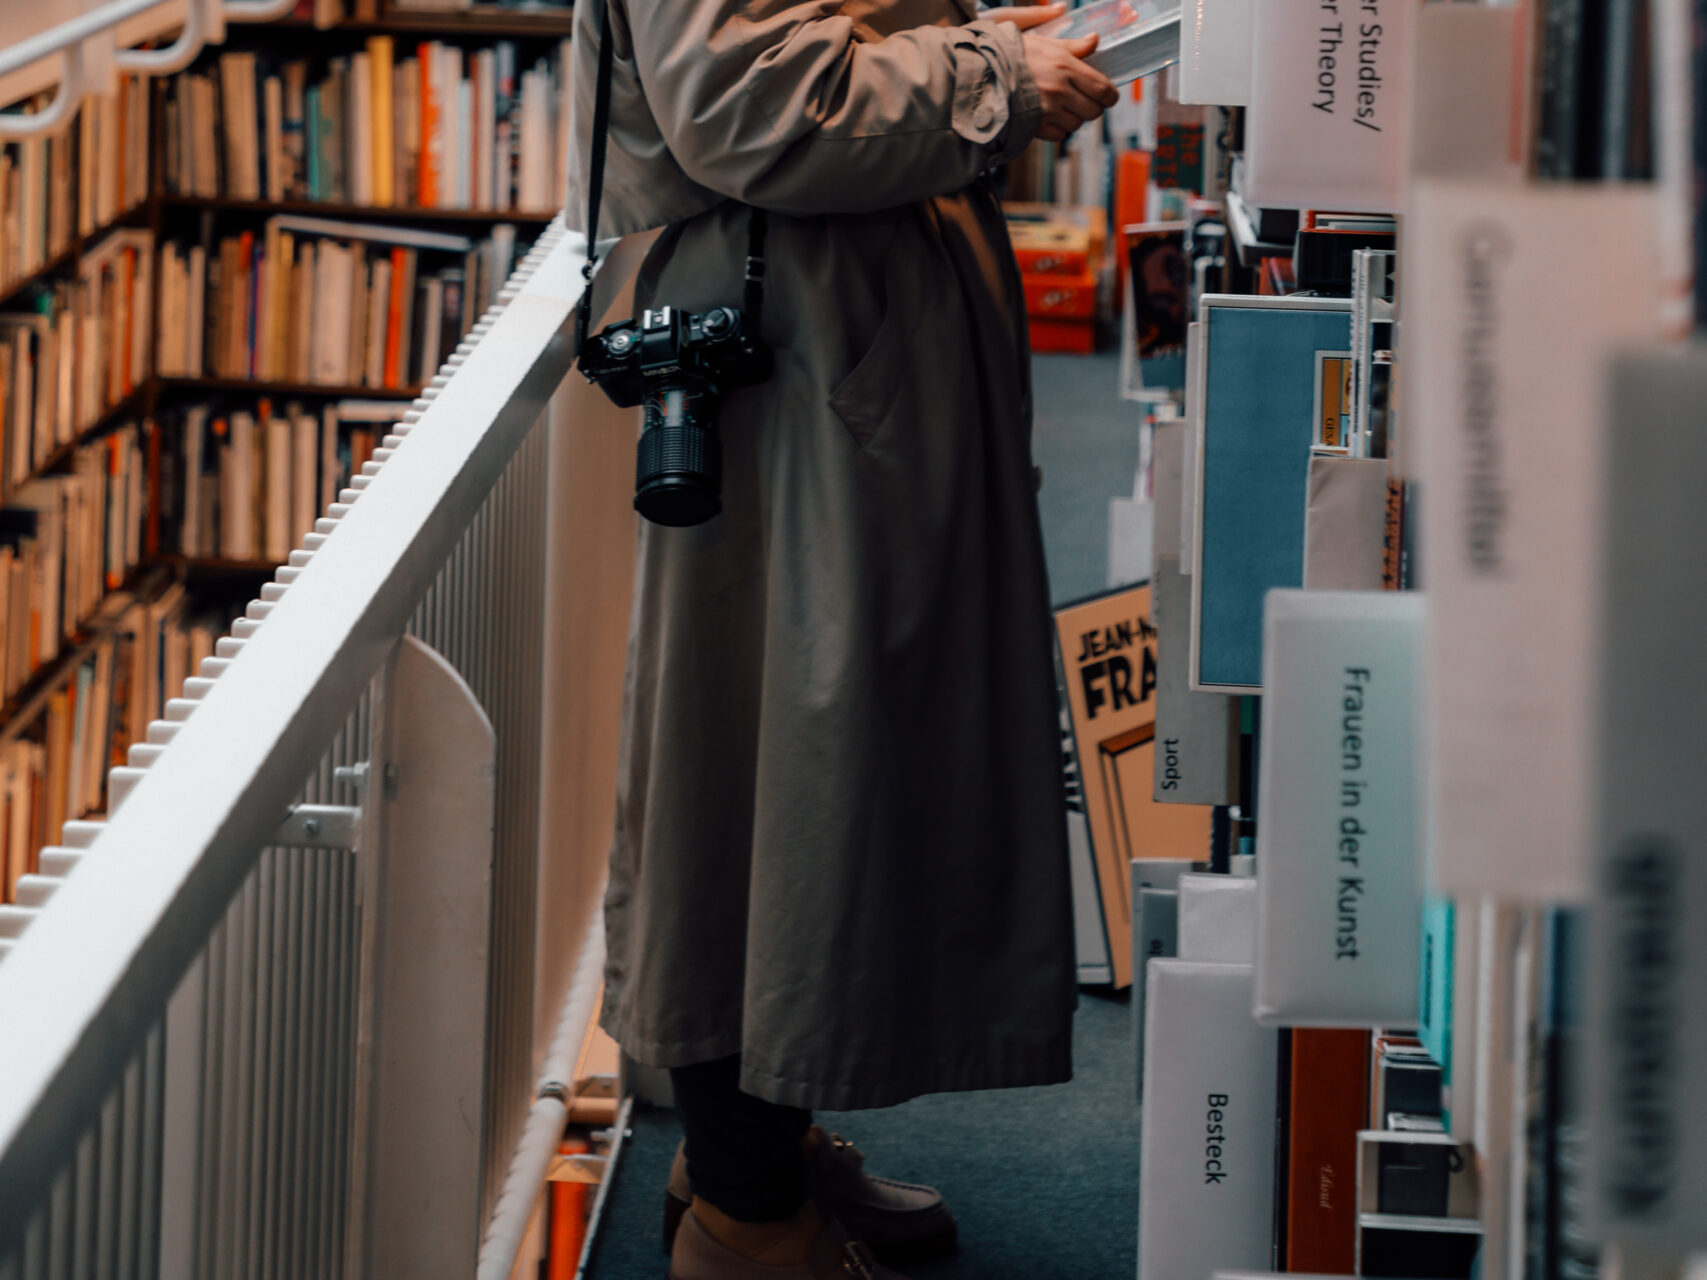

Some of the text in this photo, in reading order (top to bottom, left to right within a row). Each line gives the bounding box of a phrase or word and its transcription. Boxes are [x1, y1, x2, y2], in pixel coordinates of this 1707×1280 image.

[1312, 23, 1343, 115] Theory
[1353, 23, 1384, 132] Studies/
[1162, 738, 1181, 790] Sport
[1335, 666, 1370, 960] Frauen in der Kunst
[1206, 1093, 1229, 1184] Besteck
